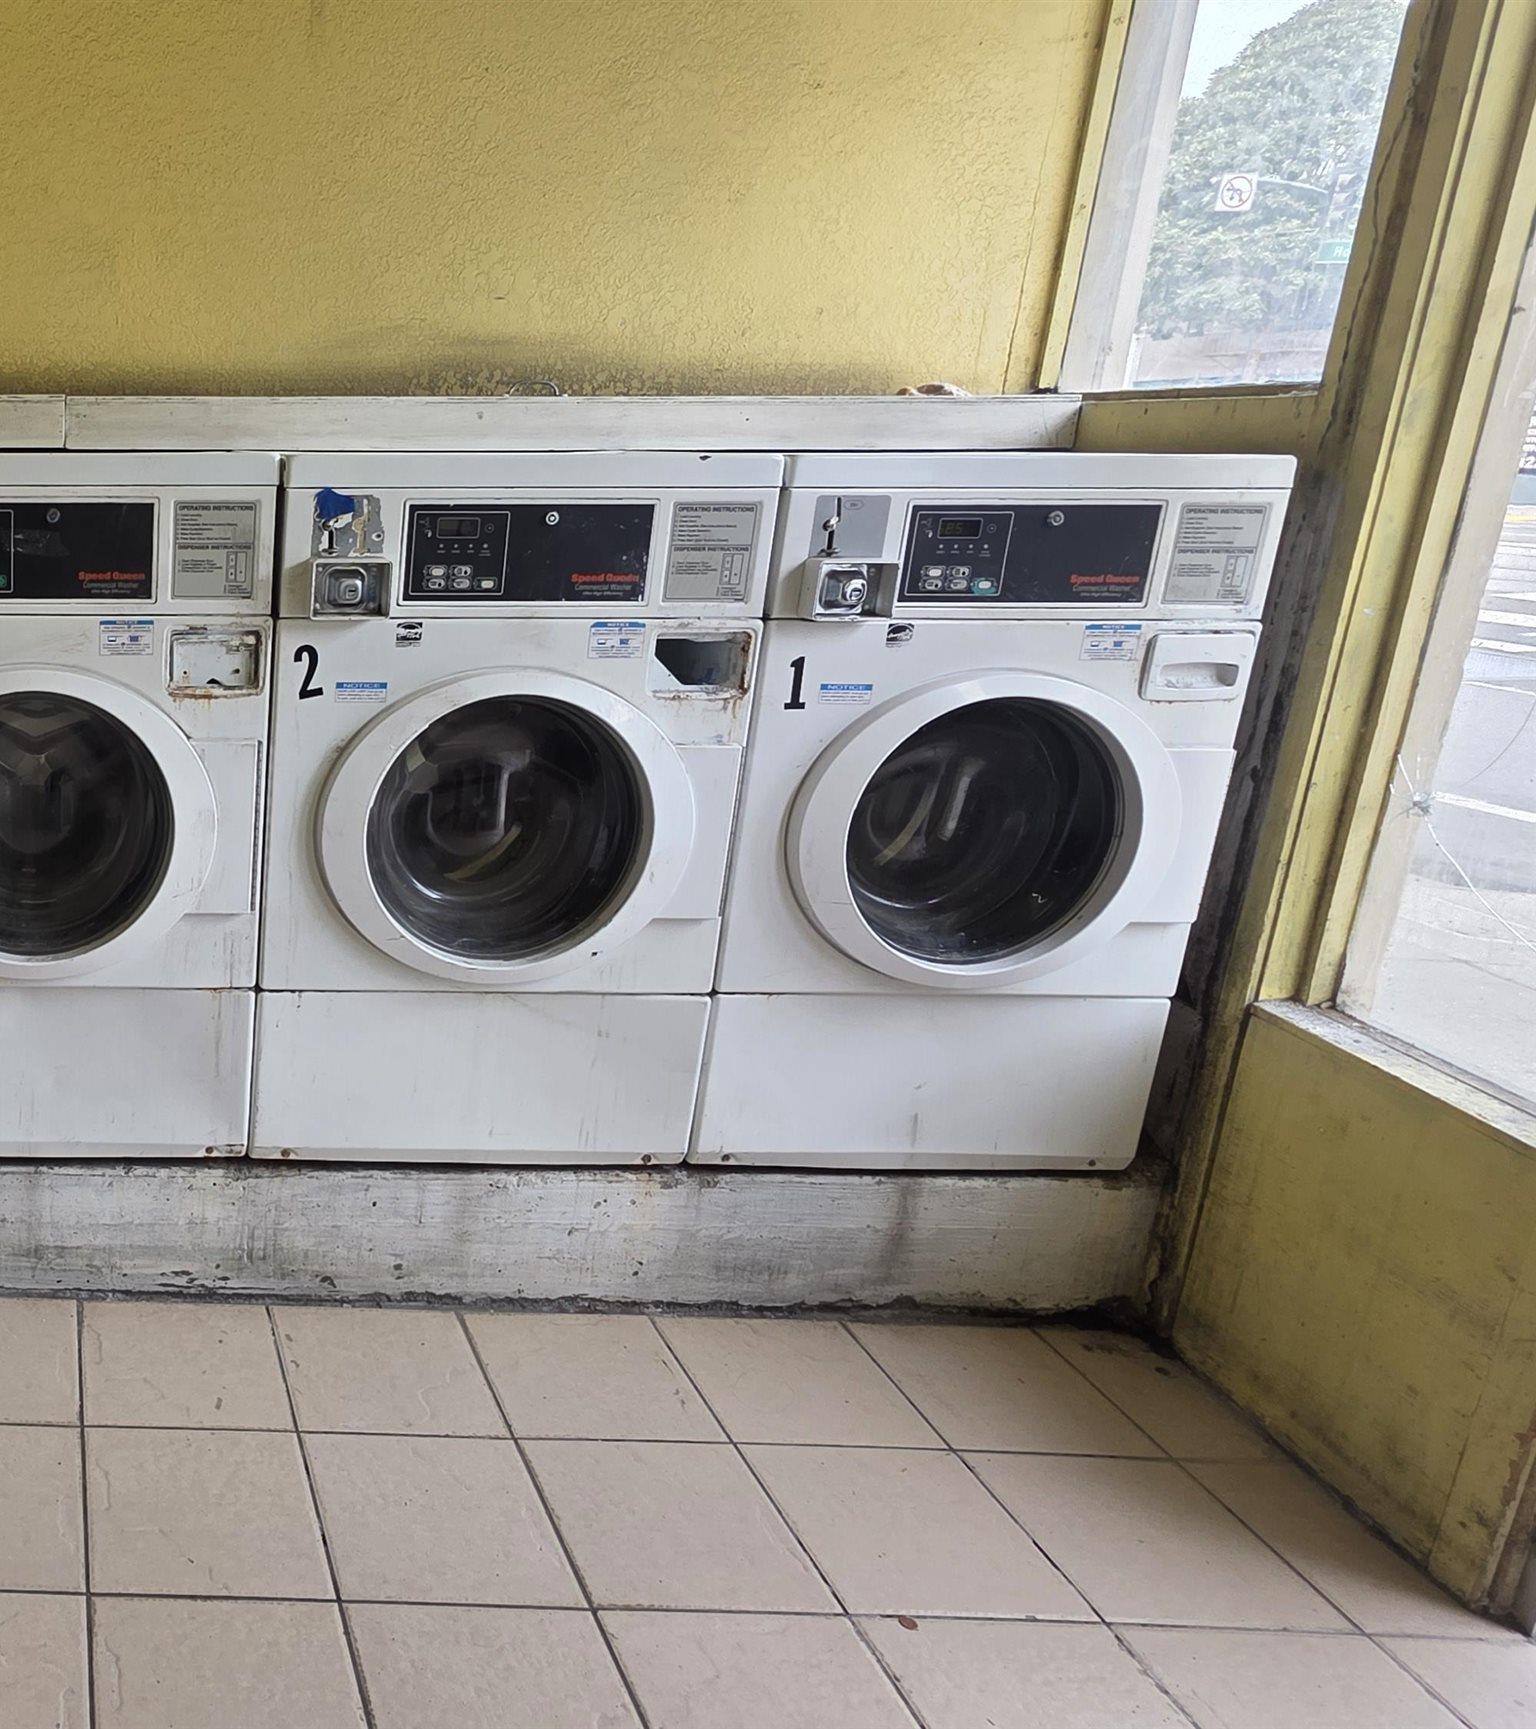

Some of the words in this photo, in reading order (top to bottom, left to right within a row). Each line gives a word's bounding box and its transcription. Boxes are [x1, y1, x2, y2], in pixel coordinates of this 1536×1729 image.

[78, 571, 111, 580] Speed
[571, 573, 604, 583] Speed
[1071, 574, 1104, 584] Speed
[1106, 574, 1140, 582] Queen
[293, 644, 323, 700] 2
[784, 656, 805, 709] 1
